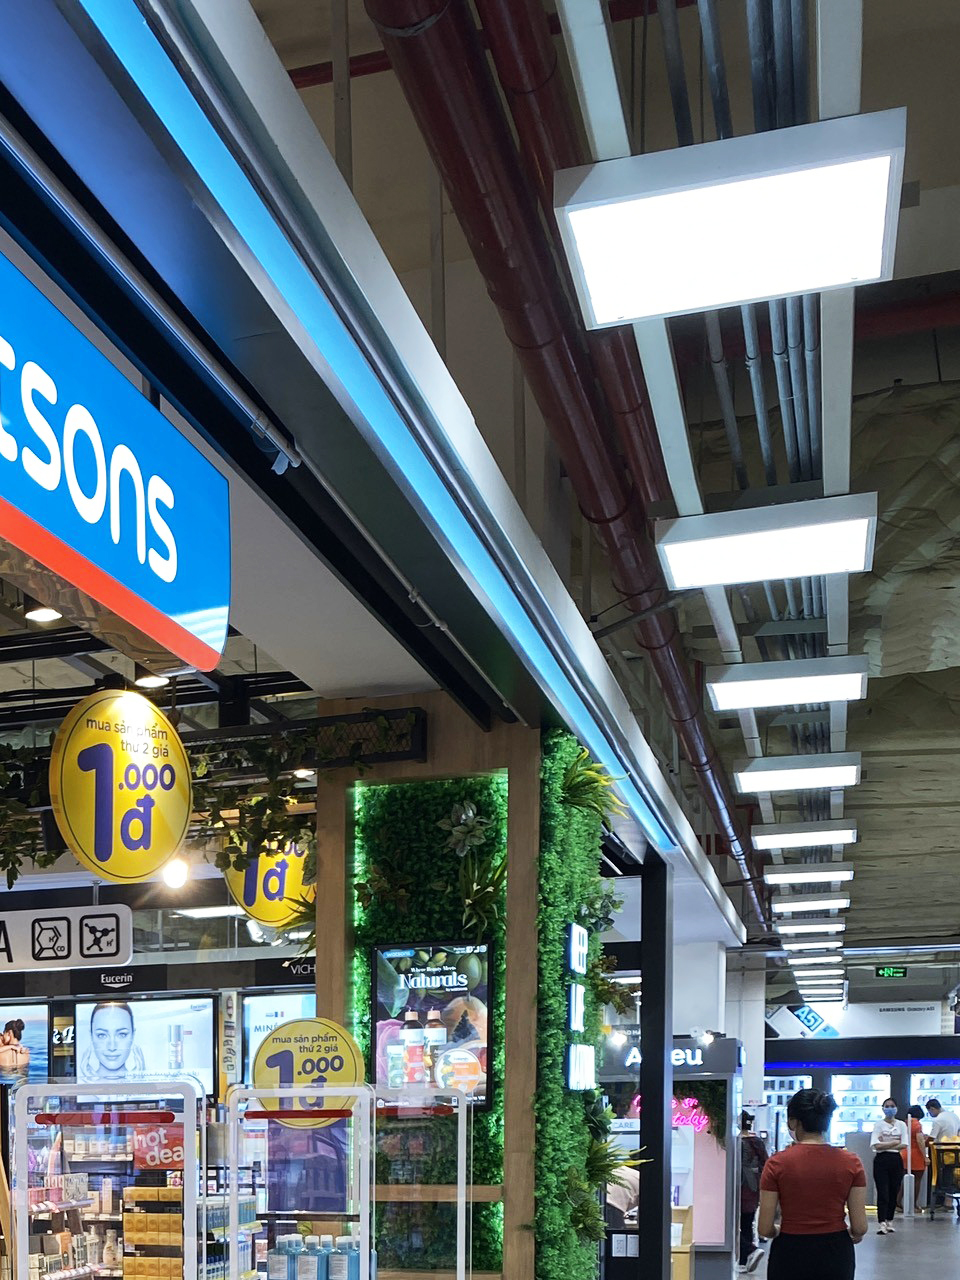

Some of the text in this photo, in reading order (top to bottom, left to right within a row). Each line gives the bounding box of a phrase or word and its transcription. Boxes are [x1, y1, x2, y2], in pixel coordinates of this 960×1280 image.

[86, 718, 111, 731] mua
[143, 742, 169, 758] 2 giá
[120, 794, 155, 851] đ
[263, 858, 289, 901] đ
[101, 973, 133, 983] Eucerin
[290, 964, 316, 974] VICH
[399, 971, 468, 989] Naturals
[795, 1006, 822, 1030] A51
[316, 1045, 322, 1053] 2
[672, 1109, 708, 1132] today
[134, 1128, 184, 1167] hot dea
